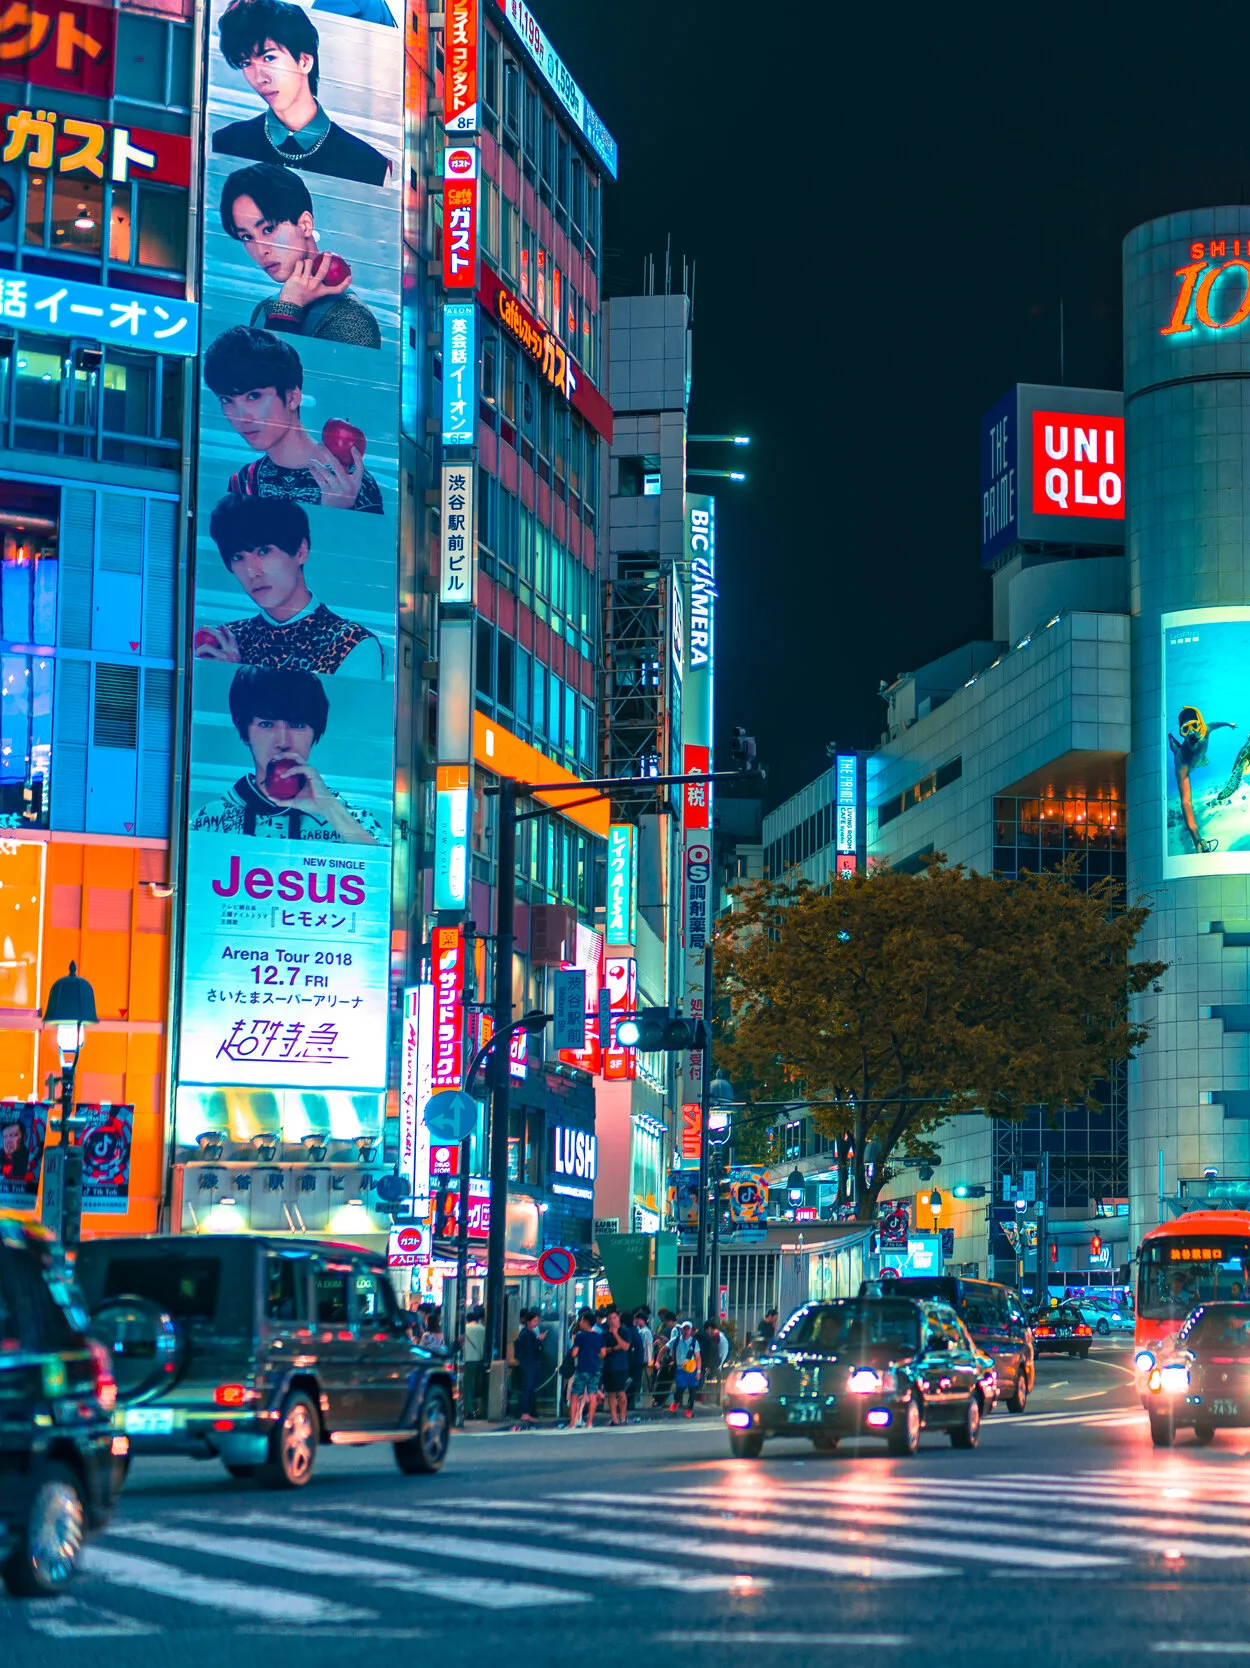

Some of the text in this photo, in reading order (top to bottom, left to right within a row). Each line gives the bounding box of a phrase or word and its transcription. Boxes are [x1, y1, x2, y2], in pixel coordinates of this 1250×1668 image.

[457, 116, 474, 129] 8F
[4, 111, 155, 182] ガスト
[451, 160, 471, 168] ガスト
[450, 207, 471, 273] ガスト
[0, 280, 188, 338] 話イーオン
[450, 318, 467, 430] 英会話イーオン
[450, 433, 466, 444] 6F
[989, 415, 1008, 479] THE
[1044, 425, 1115, 465] UNI
[983, 468, 1015, 544] PRIME
[1044, 467, 1122, 509] QLO
[448, 474, 466, 591] 渋谷駅前ビル
[691, 509, 709, 551] BIC
[840, 759, 853, 803] THE PRIME
[212, 856, 366, 905] Jesus
[303, 857, 365, 870] NEW SINGLE
[688, 885, 707, 949] 調剤薬局
[222, 946, 353, 966] Arena Tour 2018
[250, 965, 329, 988] 12.7 FRI
[207, 988, 363, 1010] さいたまスーパーアリーナ
[568, 976, 582, 1043] 渋谷駅前
[609, 1060, 623, 1069] 3F
[555, 1126, 596, 1180] LUSH
[401, 1236, 420, 1246] ガスト
